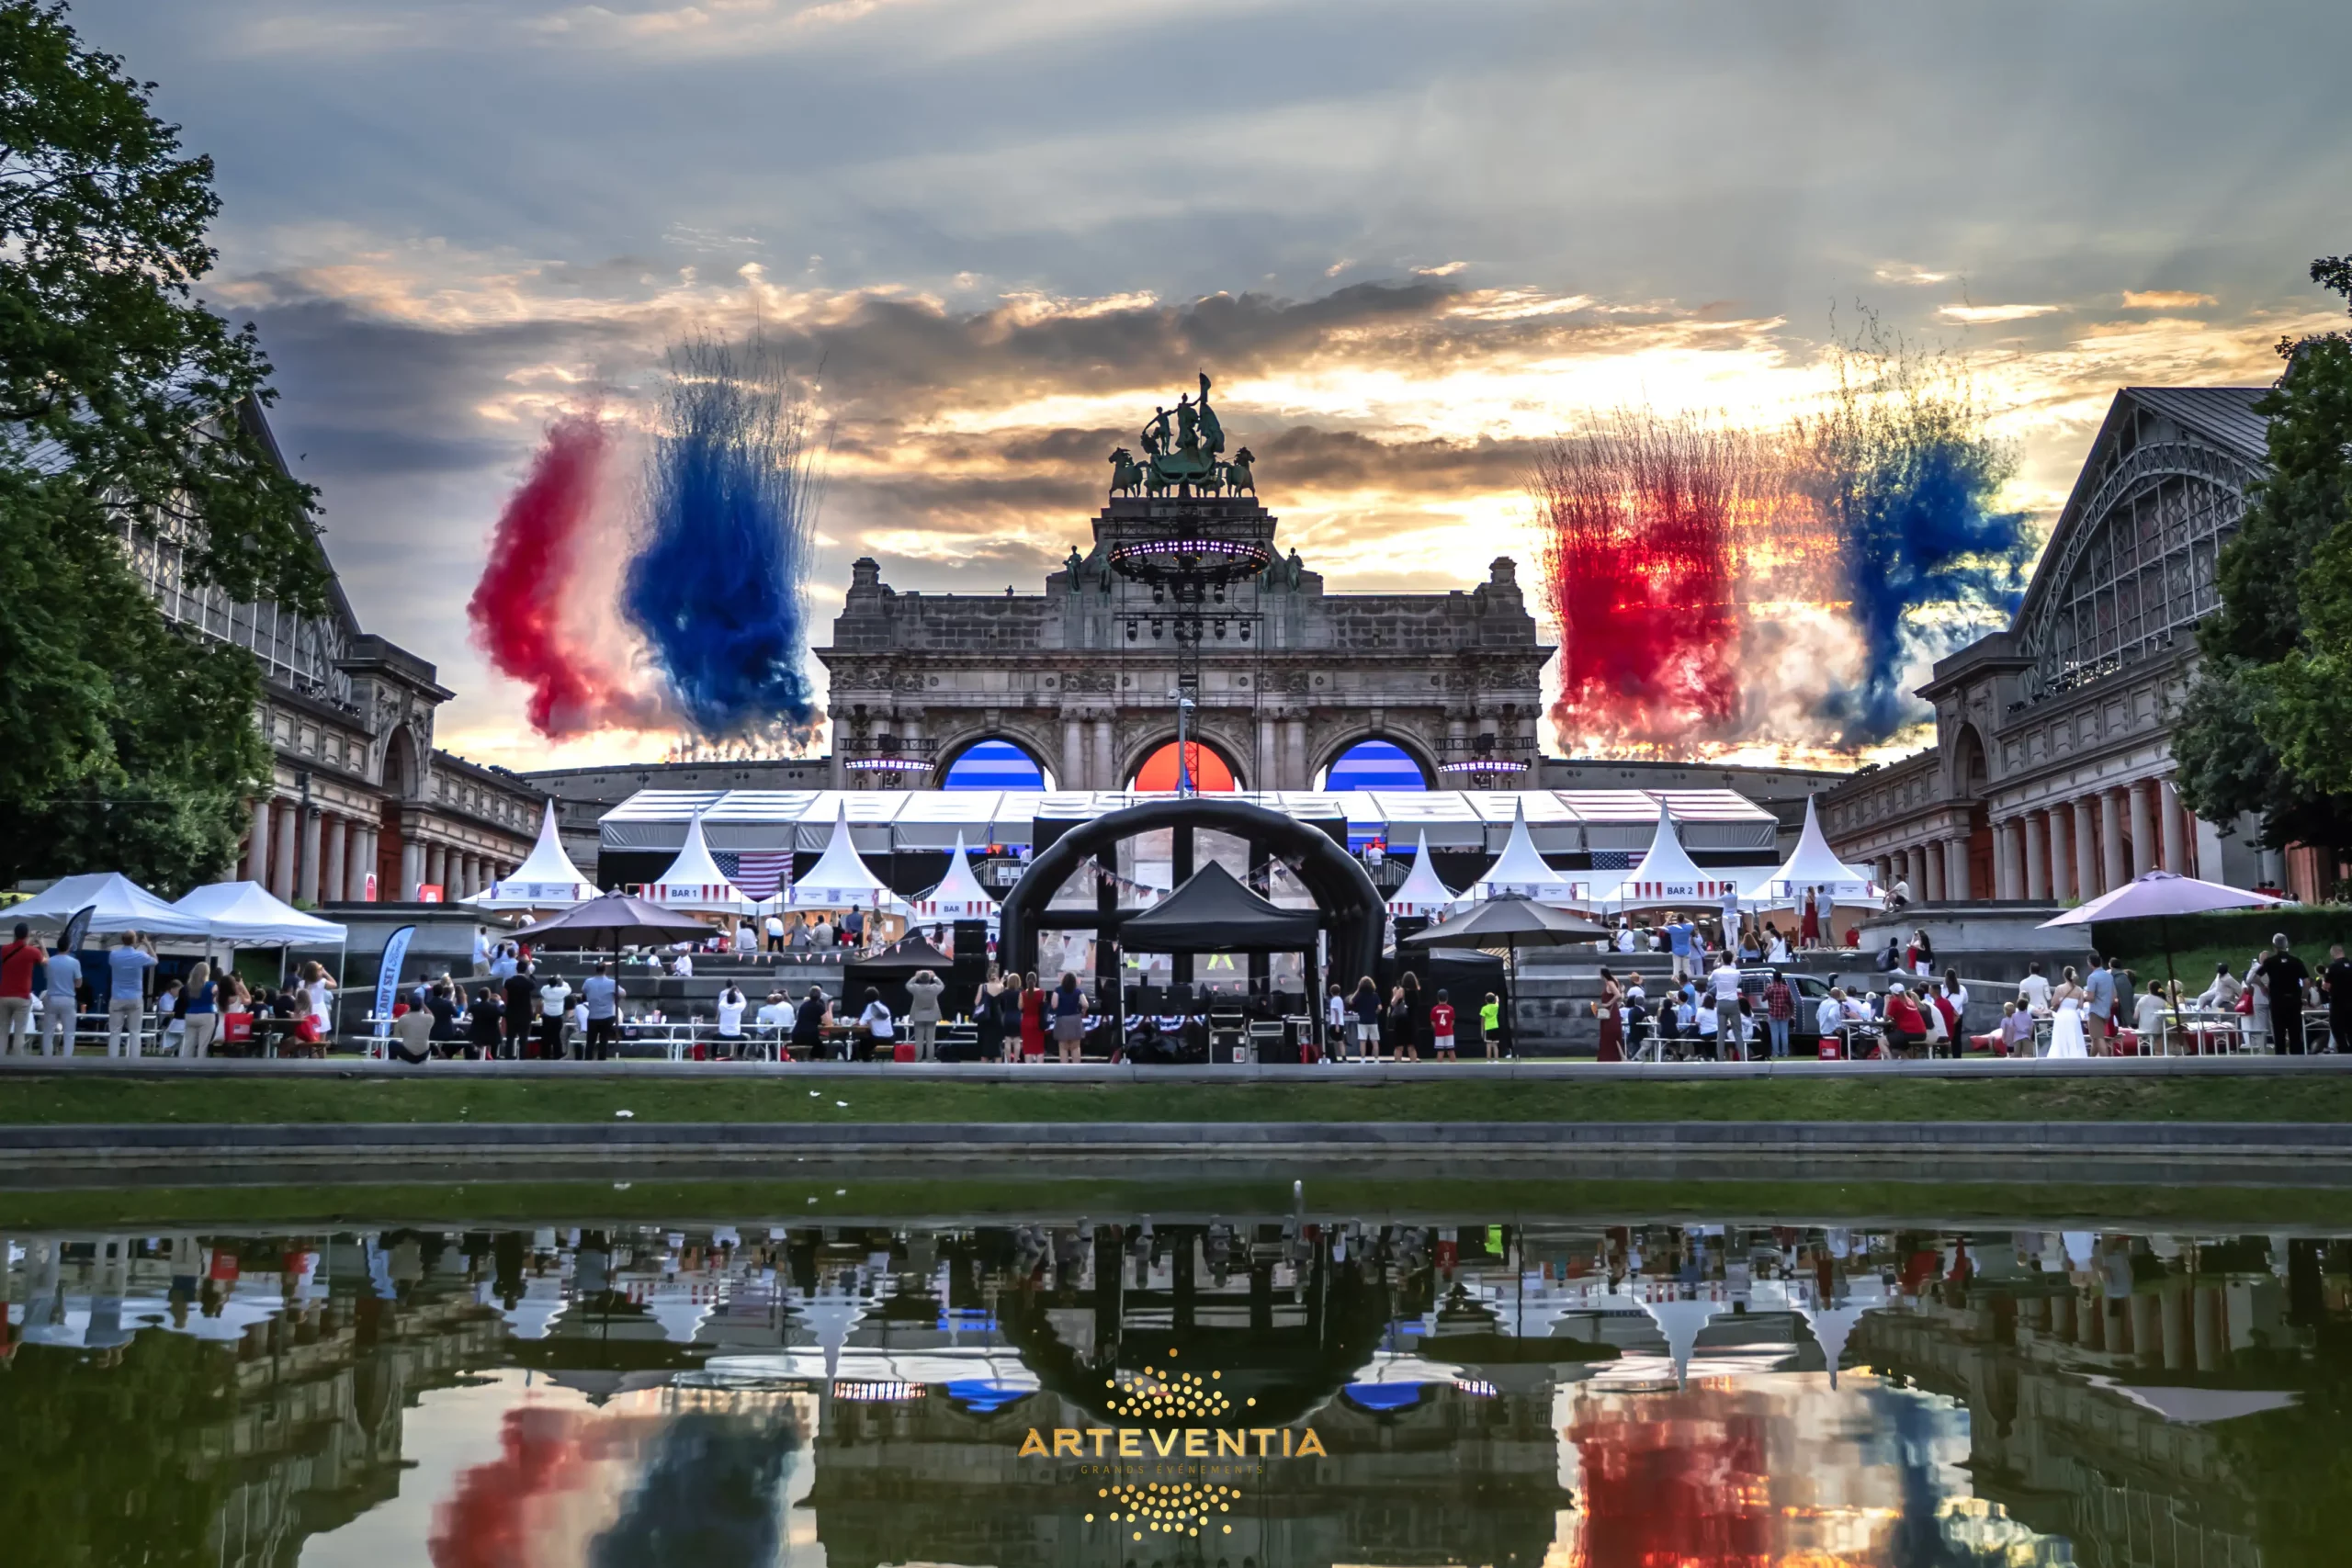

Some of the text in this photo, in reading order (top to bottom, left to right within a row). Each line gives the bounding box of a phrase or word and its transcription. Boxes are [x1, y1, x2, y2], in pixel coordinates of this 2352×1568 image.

[672, 889, 697, 897] BAR 1
[1667, 886, 1693, 895] BAR 2
[383, 966, 396, 987] SET
